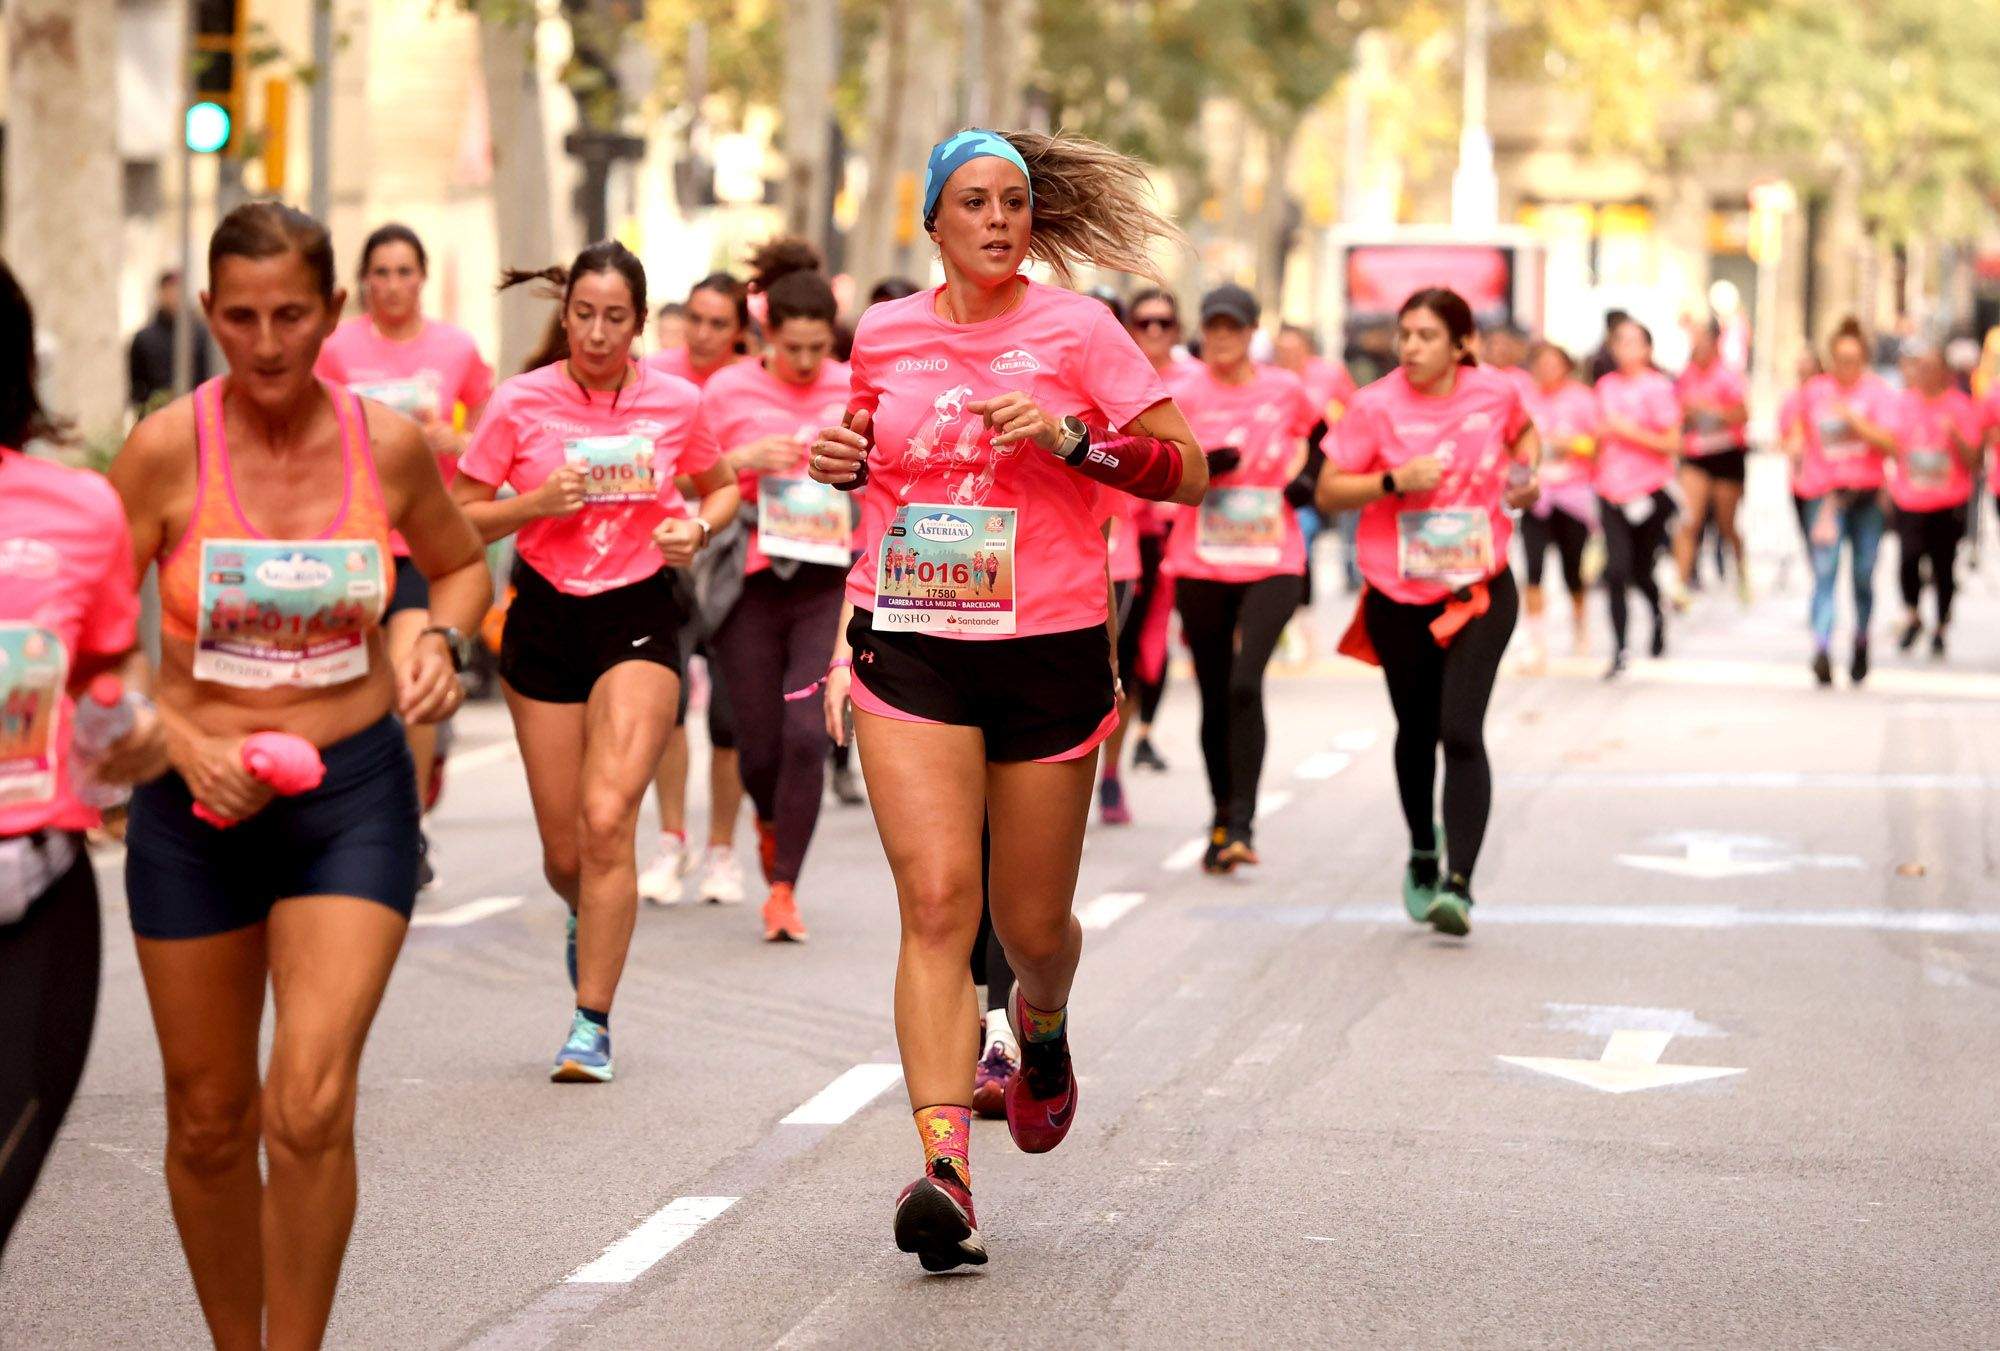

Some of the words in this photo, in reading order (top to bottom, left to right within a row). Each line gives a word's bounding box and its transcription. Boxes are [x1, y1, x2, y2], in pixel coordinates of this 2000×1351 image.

[896, 358, 948, 372] OYSHO
[592, 464, 633, 481] 016
[918, 523, 969, 537] ASTURIANA
[917, 562, 969, 584] 016
[926, 588, 957, 599] 17580
[888, 598, 914, 606] CARRERA
[962, 601, 1001, 609] BARCELONA
[888, 613, 931, 624] OYSHO
[957, 617, 1000, 626] Santander
